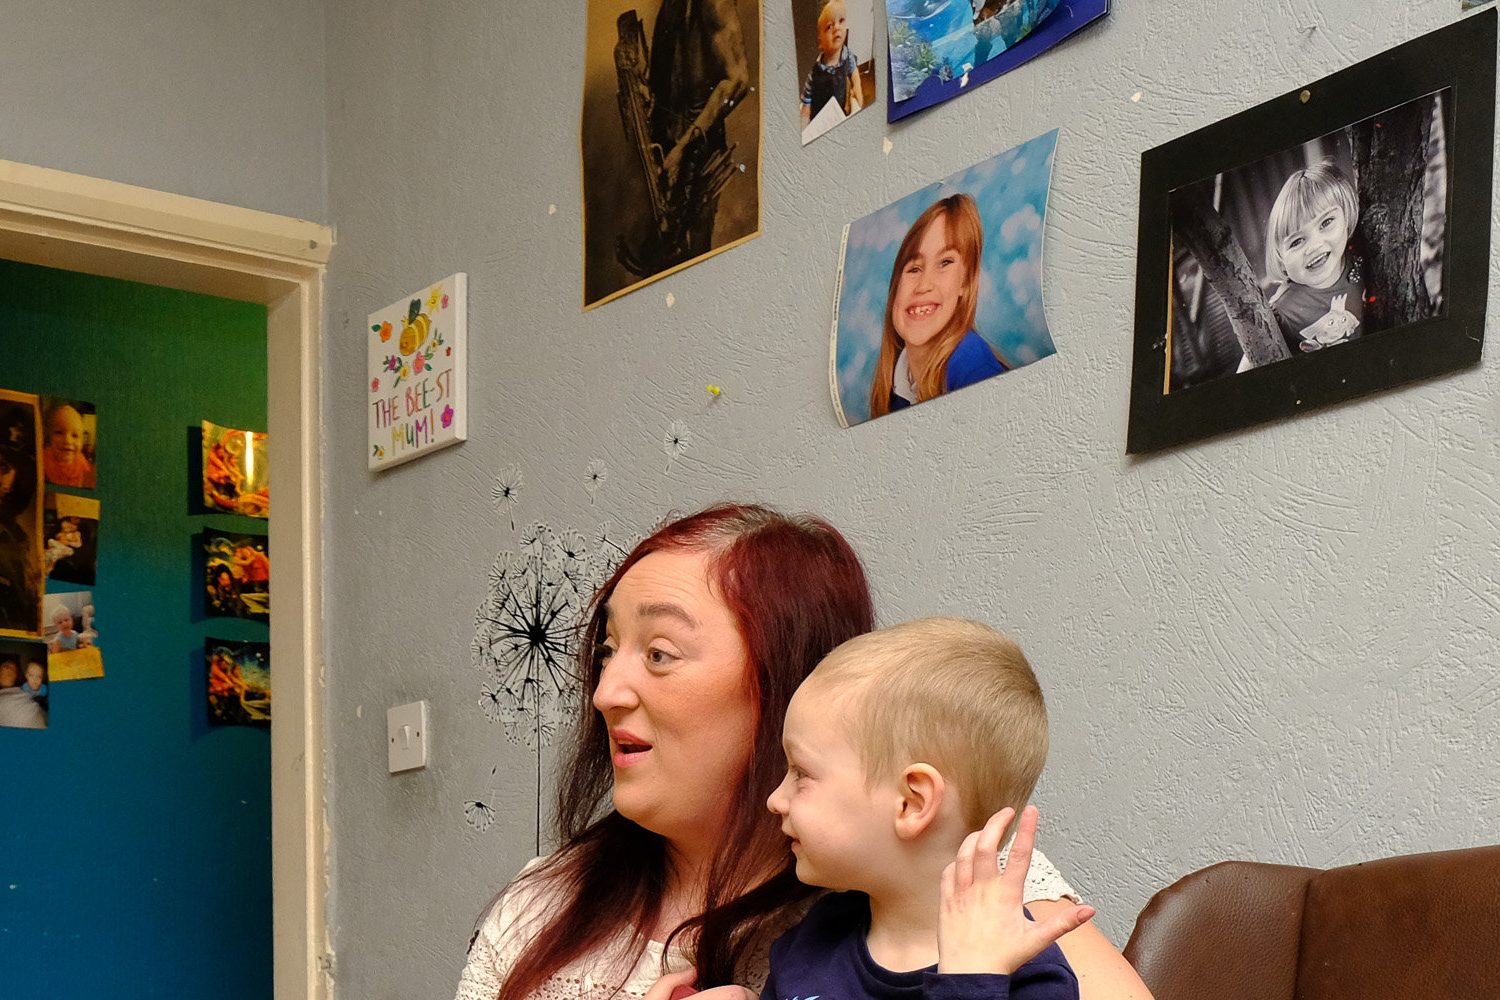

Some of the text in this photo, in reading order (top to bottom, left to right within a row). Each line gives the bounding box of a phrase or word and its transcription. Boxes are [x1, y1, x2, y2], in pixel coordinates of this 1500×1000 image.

[372, 368, 452, 429] THE BEE-ST
[391, 407, 436, 457] MUM!
